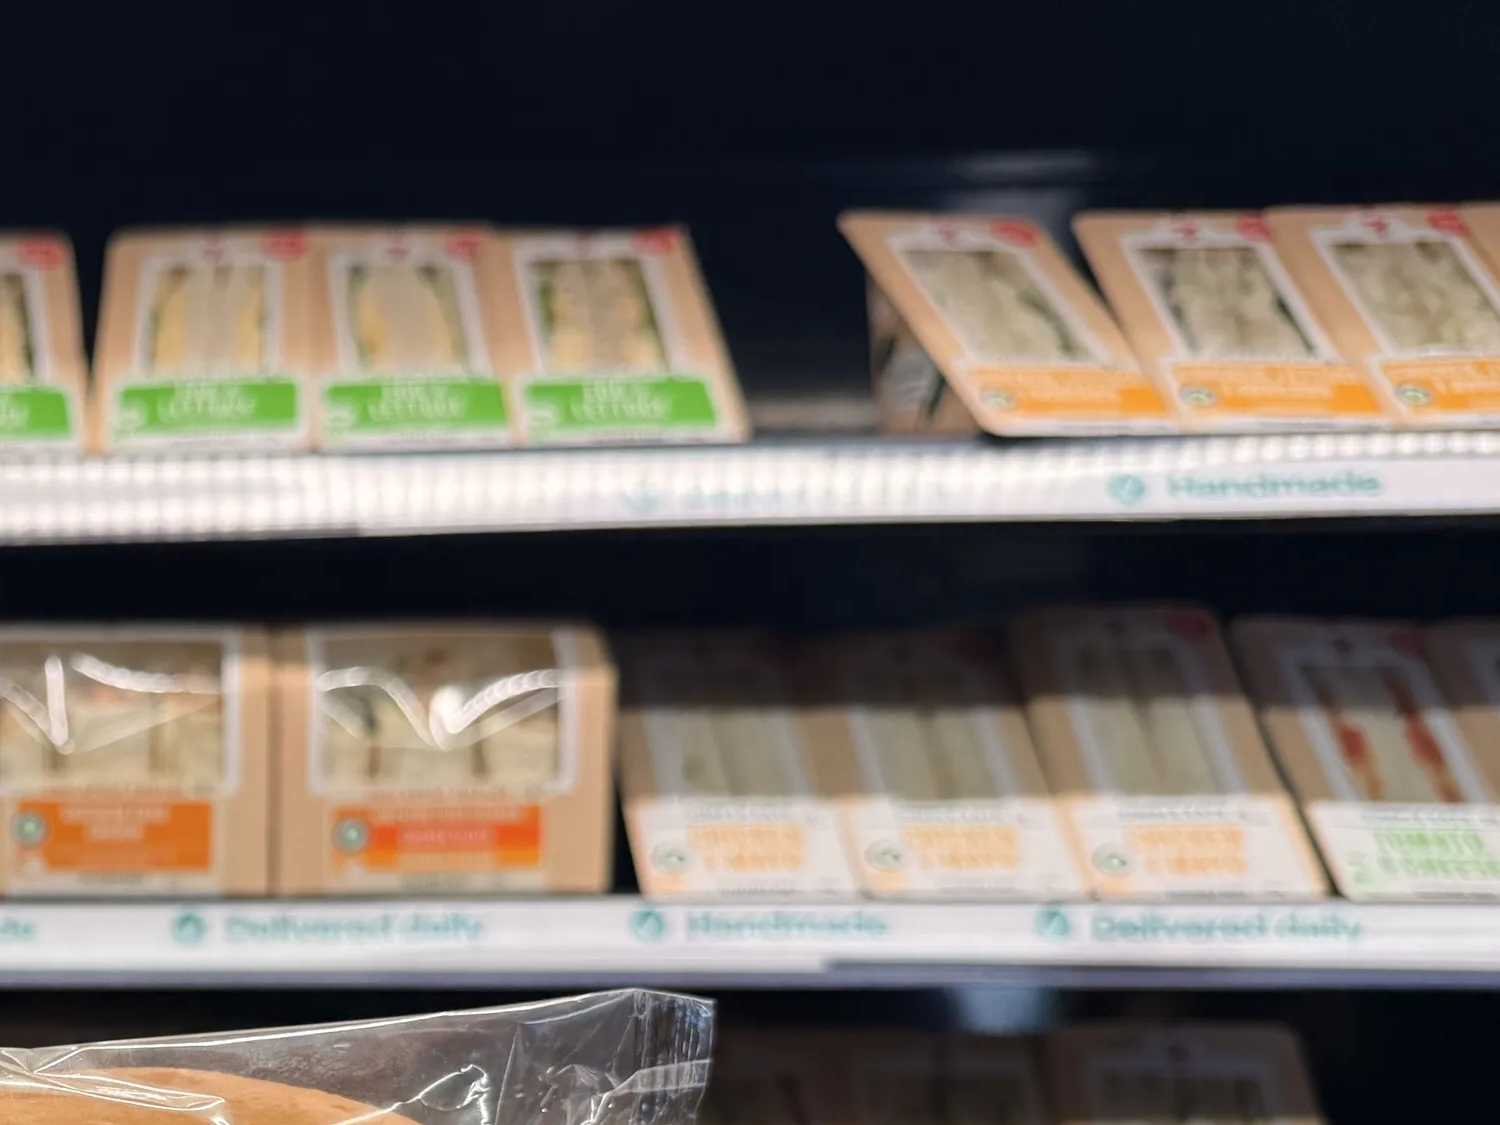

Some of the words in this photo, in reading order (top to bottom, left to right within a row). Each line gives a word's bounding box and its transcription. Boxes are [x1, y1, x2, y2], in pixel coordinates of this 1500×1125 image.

[1166, 468, 1383, 500] Handmade
[224, 913, 391, 942] Delivered
[684, 909, 890, 937] Handmade
[1093, 911, 1267, 940] Delivered
